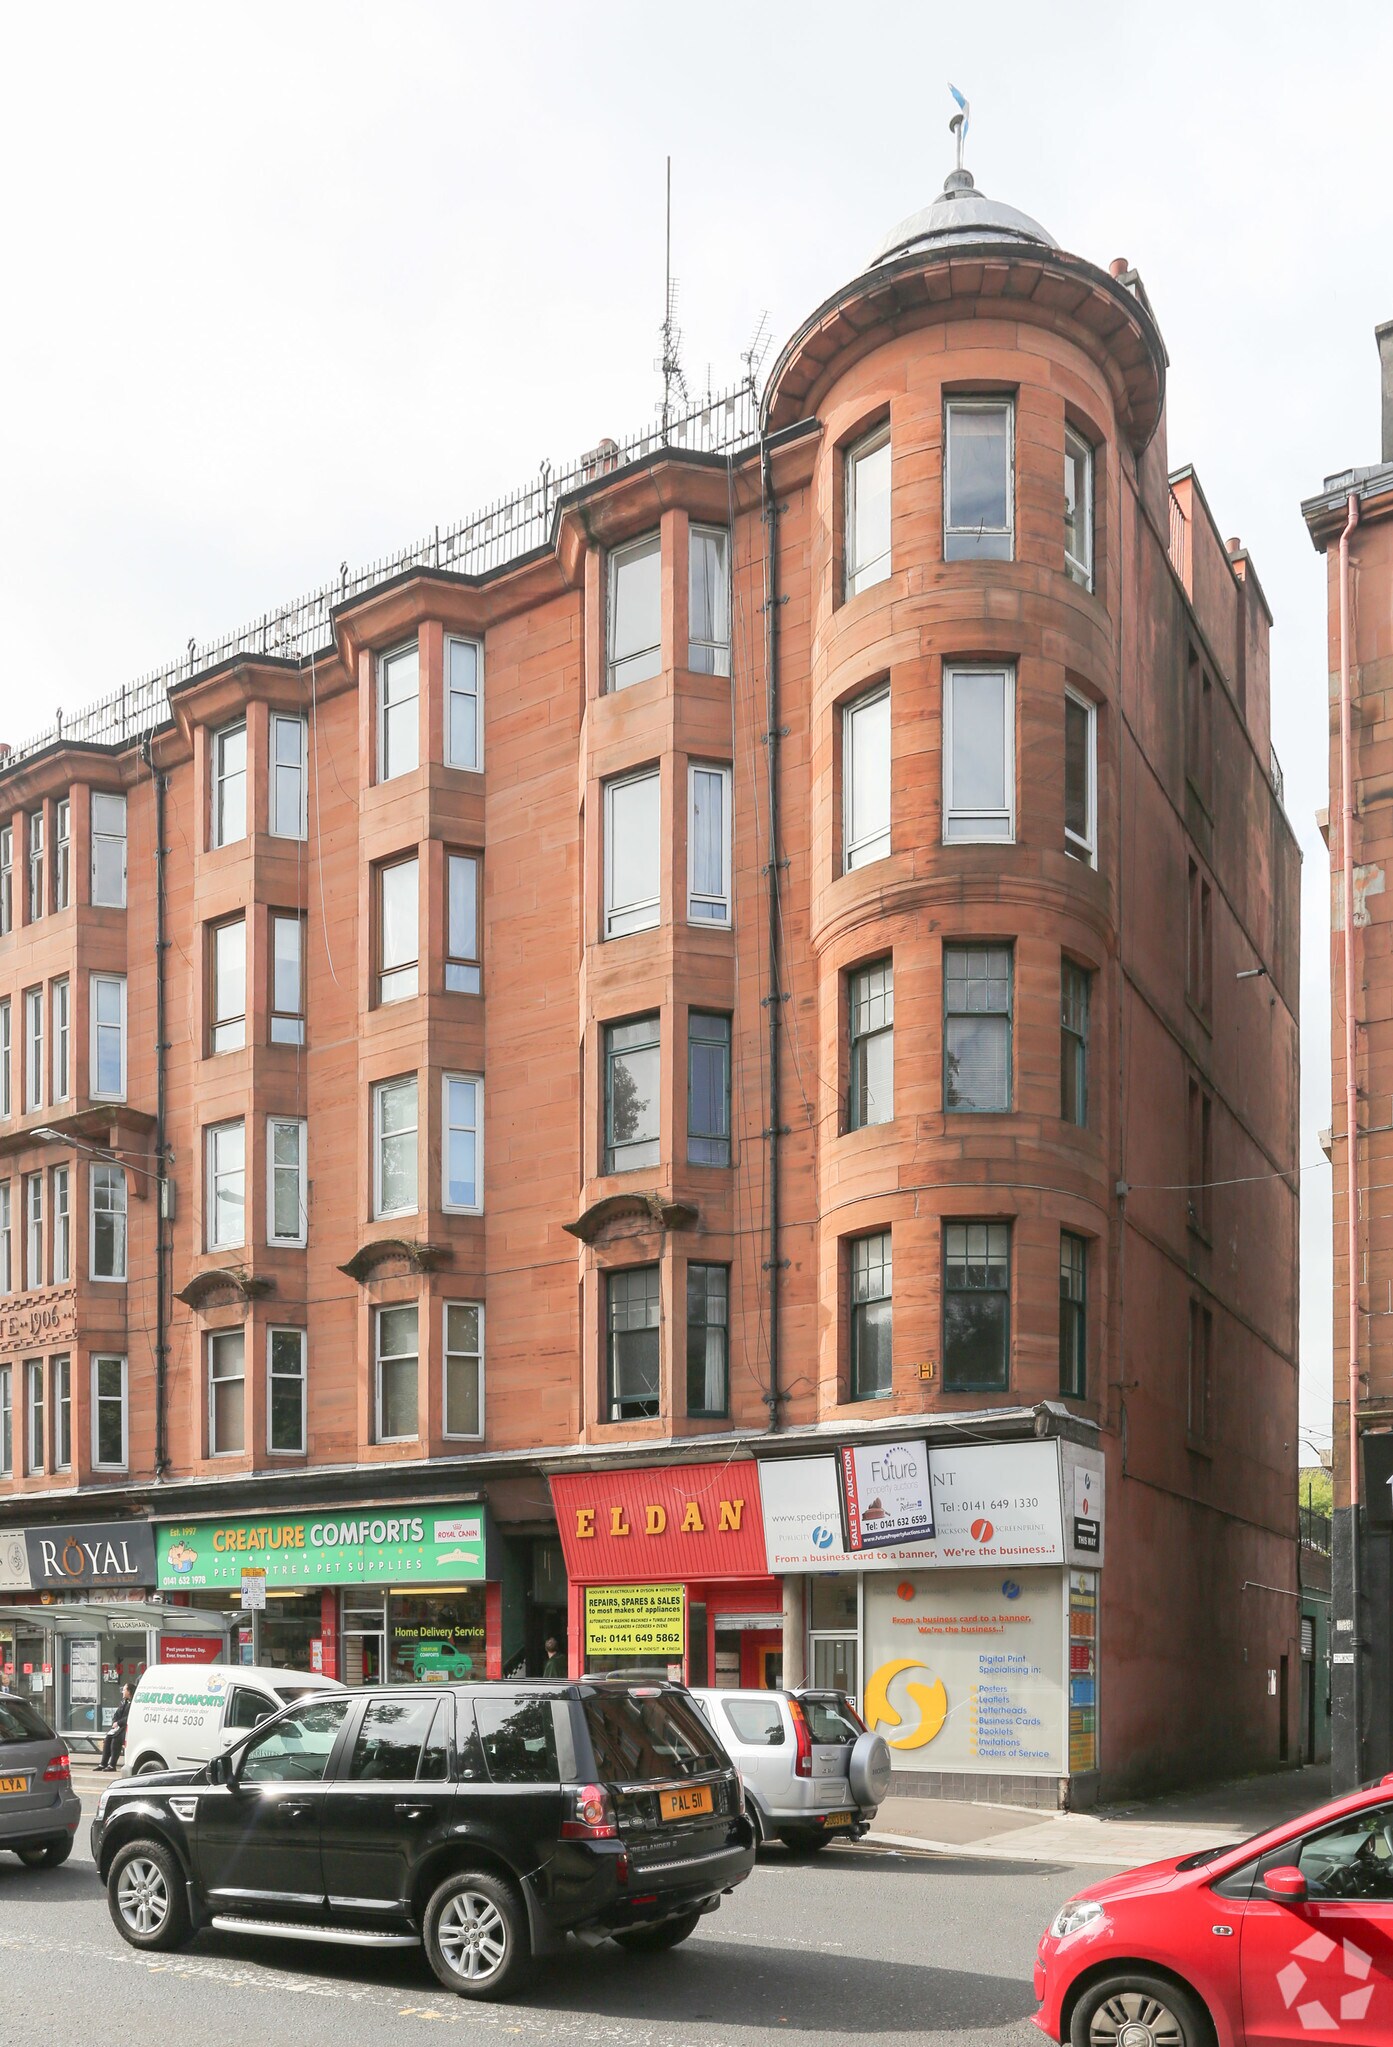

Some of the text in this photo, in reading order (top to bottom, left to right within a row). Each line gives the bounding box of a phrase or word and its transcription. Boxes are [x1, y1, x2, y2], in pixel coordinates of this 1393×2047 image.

[30, 1305, 60, 1335] 1906
[871, 1461, 917, 1482] Future
[844, 1451, 858, 1546] SALE by AUCTION
[990, 1499, 1009, 1510] 649
[1013, 1498, 1038, 1508] 1330
[576, 1500, 744, 1538] ELDAN
[866, 1514, 927, 1531] Tel: 0141 632 6599
[170, 1527, 197, 1537] Est. 1997
[213, 1518, 424, 1552] CREATURE COMFORTS
[937, 1527, 969, 1535] JACKSON
[1078, 1536, 1096, 1547] THIS WAY
[40, 1536, 138, 1577] ROYAL
[775, 1554, 800, 1563] From
[810, 1553, 850, 1562] business
[853, 1551, 876, 1561] card
[877, 1551, 886, 1560] to
[899, 1550, 937, 1559] banner,
[943, 1548, 976, 1557] We're
[979, 1547, 997, 1556] the
[1000, 1544, 1055, 1555] business..!
[214, 1568, 236, 1577] PET
[303, 1565, 310, 1573] &
[317, 1563, 341, 1573] PET
[348, 1559, 422, 1572] SUPPLIES
[163, 1575, 206, 1585] 0141 632 1978
[589, 1596, 680, 1607] REPAIRS, SPARES & SALES
[645, 1606, 680, 1614] appliances
[892, 1616, 914, 1624] From
[922, 1615, 957, 1623] business
[959, 1615, 977, 1623] card
[998, 1614, 1032, 1623] banner,
[395, 1626, 485, 1639] Home Delivery Service
[917, 1626, 943, 1634] We're
[590, 1633, 680, 1643] Tel: 0141 649 5862
[979, 1655, 1005, 1664] Digital
[979, 1666, 1028, 1675] Specialising
[134, 1692, 225, 1707] CREATURE COMFORTS
[979, 1706, 1027, 1714] Letterheads
[144, 1713, 204, 1726] 0141 644 5030
[1015, 1717, 1041, 1725] Cards
[979, 1727, 1013, 1735] Booklets
[979, 1738, 1020, 1746] Invitations
[979, 1748, 1006, 1756] Orders
[2, 1778, 22, 1791] LYA
[671, 1795, 690, 1812] PAL
